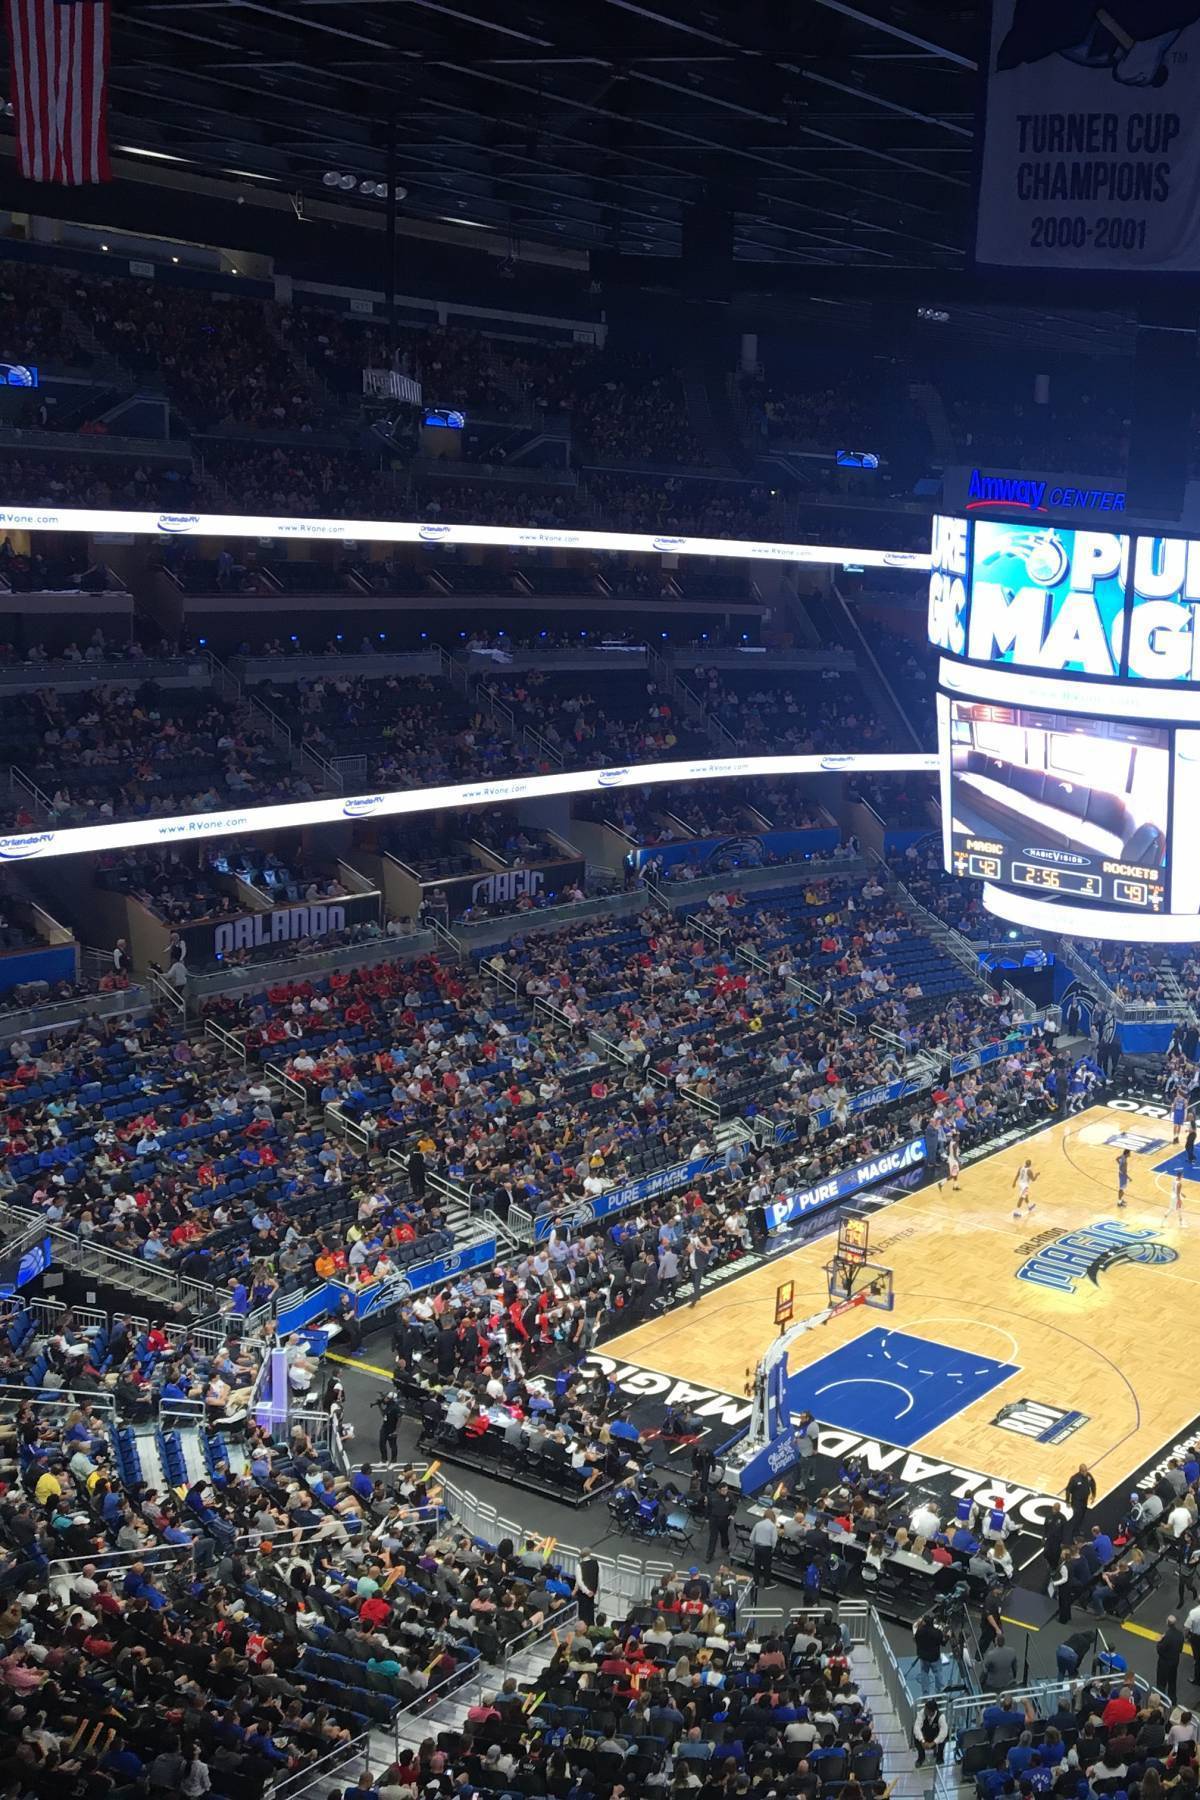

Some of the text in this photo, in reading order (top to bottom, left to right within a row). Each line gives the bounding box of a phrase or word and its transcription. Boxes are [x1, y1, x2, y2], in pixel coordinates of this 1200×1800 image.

[1016, 112, 1181, 153] TURNER CUP
[1016, 162, 1171, 202] CHAMPIONS
[968, 468, 1126, 512] Amway CENTER
[966, 839, 1004, 855] MAGIC
[978, 859, 997, 877] 42
[1026, 866, 1060, 888] 2:56
[1102, 861, 1160, 881] ROCKETS
[1124, 884, 1142, 901] 49
[214, 905, 346, 952] ORLANDO
[608, 1167, 689, 1210] PURE MAGIC
[799, 1180, 839, 1210] PURE
[856, 1152, 900, 1184] MAGIC
[1014, 1226, 1070, 1256] ORLANDO
[1015, 1220, 1162, 1294] MAGIC
[790, 1416, 1074, 1526] ORLAND
